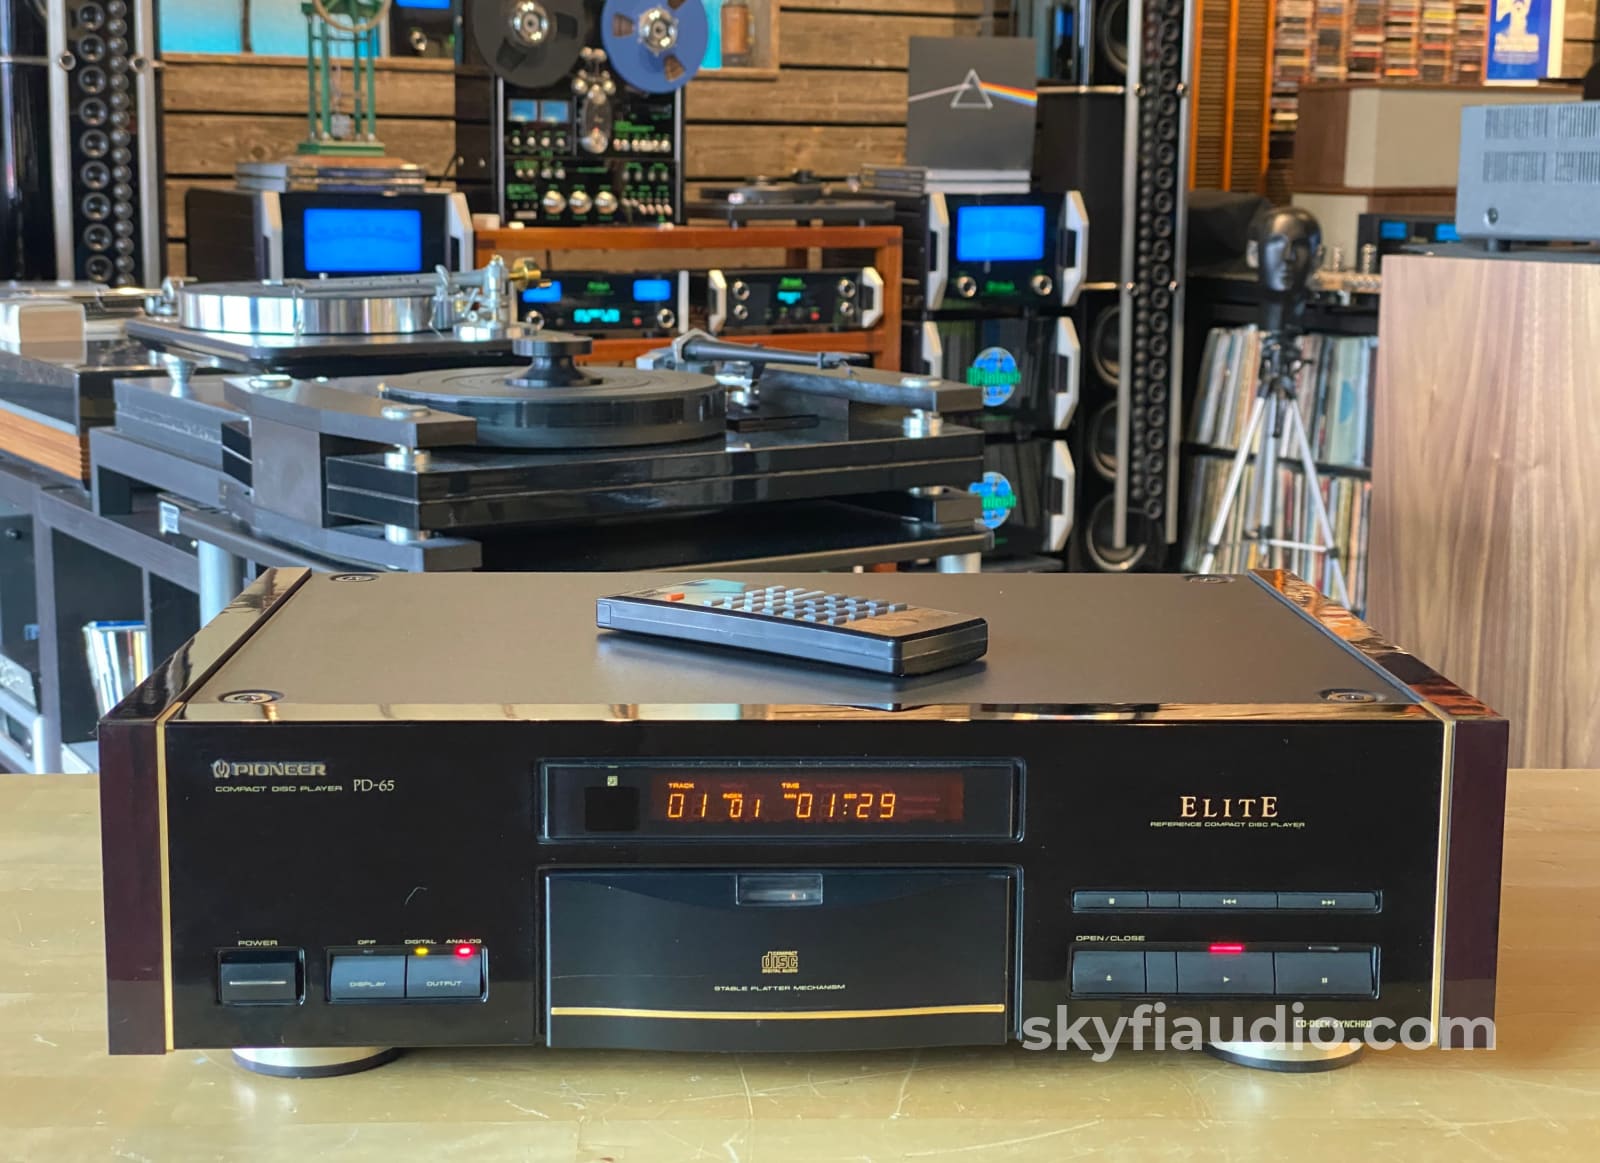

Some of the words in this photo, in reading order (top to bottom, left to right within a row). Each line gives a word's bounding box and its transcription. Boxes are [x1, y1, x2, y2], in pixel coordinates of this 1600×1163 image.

[232, 761, 327, 777] PIONEER
[215, 785, 267, 793] COMPACT
[353, 778, 396, 792] PD-65
[668, 782, 695, 790] TRACK
[781, 782, 800, 790] TIME
[667, 793, 708, 818] 01
[796, 793, 896, 818] 01:29
[238, 939, 279, 947] POWER
[349, 980, 387, 988] DISPLAY
